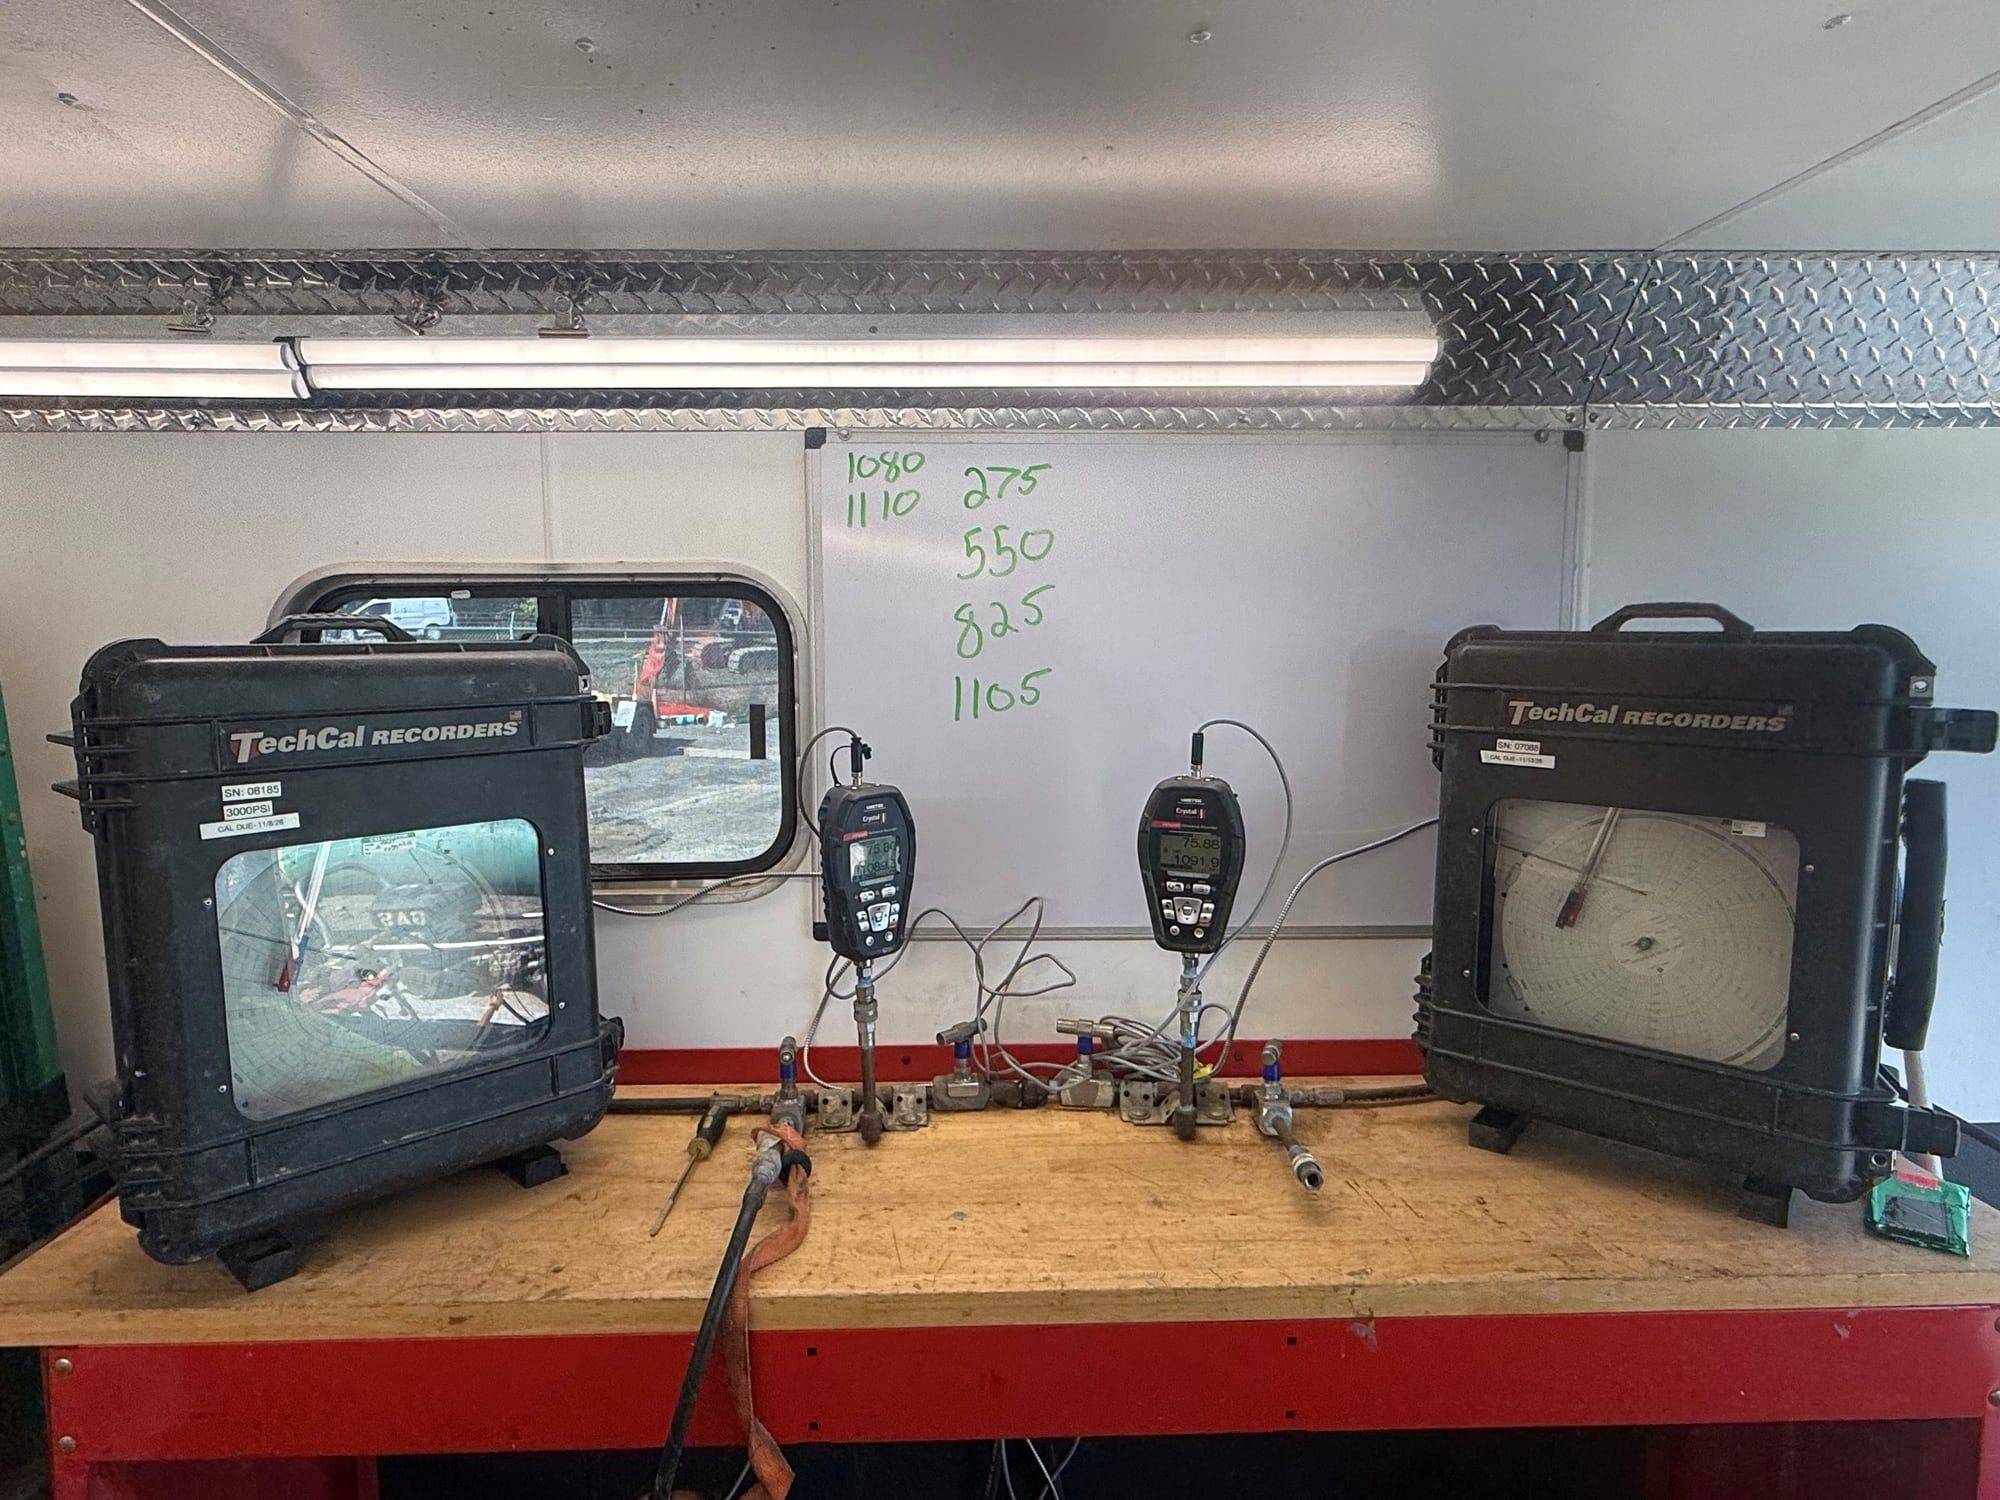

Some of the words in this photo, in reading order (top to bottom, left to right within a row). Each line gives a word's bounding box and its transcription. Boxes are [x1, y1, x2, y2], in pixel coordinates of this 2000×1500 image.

[848, 451, 925, 483] 1080
[963, 464, 1052, 509] 275
[957, 525, 1054, 580] 550
[953, 584, 1055, 659] 825
[953, 668, 1052, 721] 1105
[1509, 700, 1619, 726] TechCal
[1622, 710, 1788, 733] RECORDERS
[230, 725, 366, 764] TechCal
[371, 721, 519, 746] RECORDERS
[224, 788, 244, 798] SN:
[247, 785, 280, 796] 08185
[226, 804, 271, 818] 3000PSI
[1176, 807, 1198, 816] Crystal
[1183, 837, 1220, 850] 75.88
[1174, 854, 1219, 868] 1091.9
